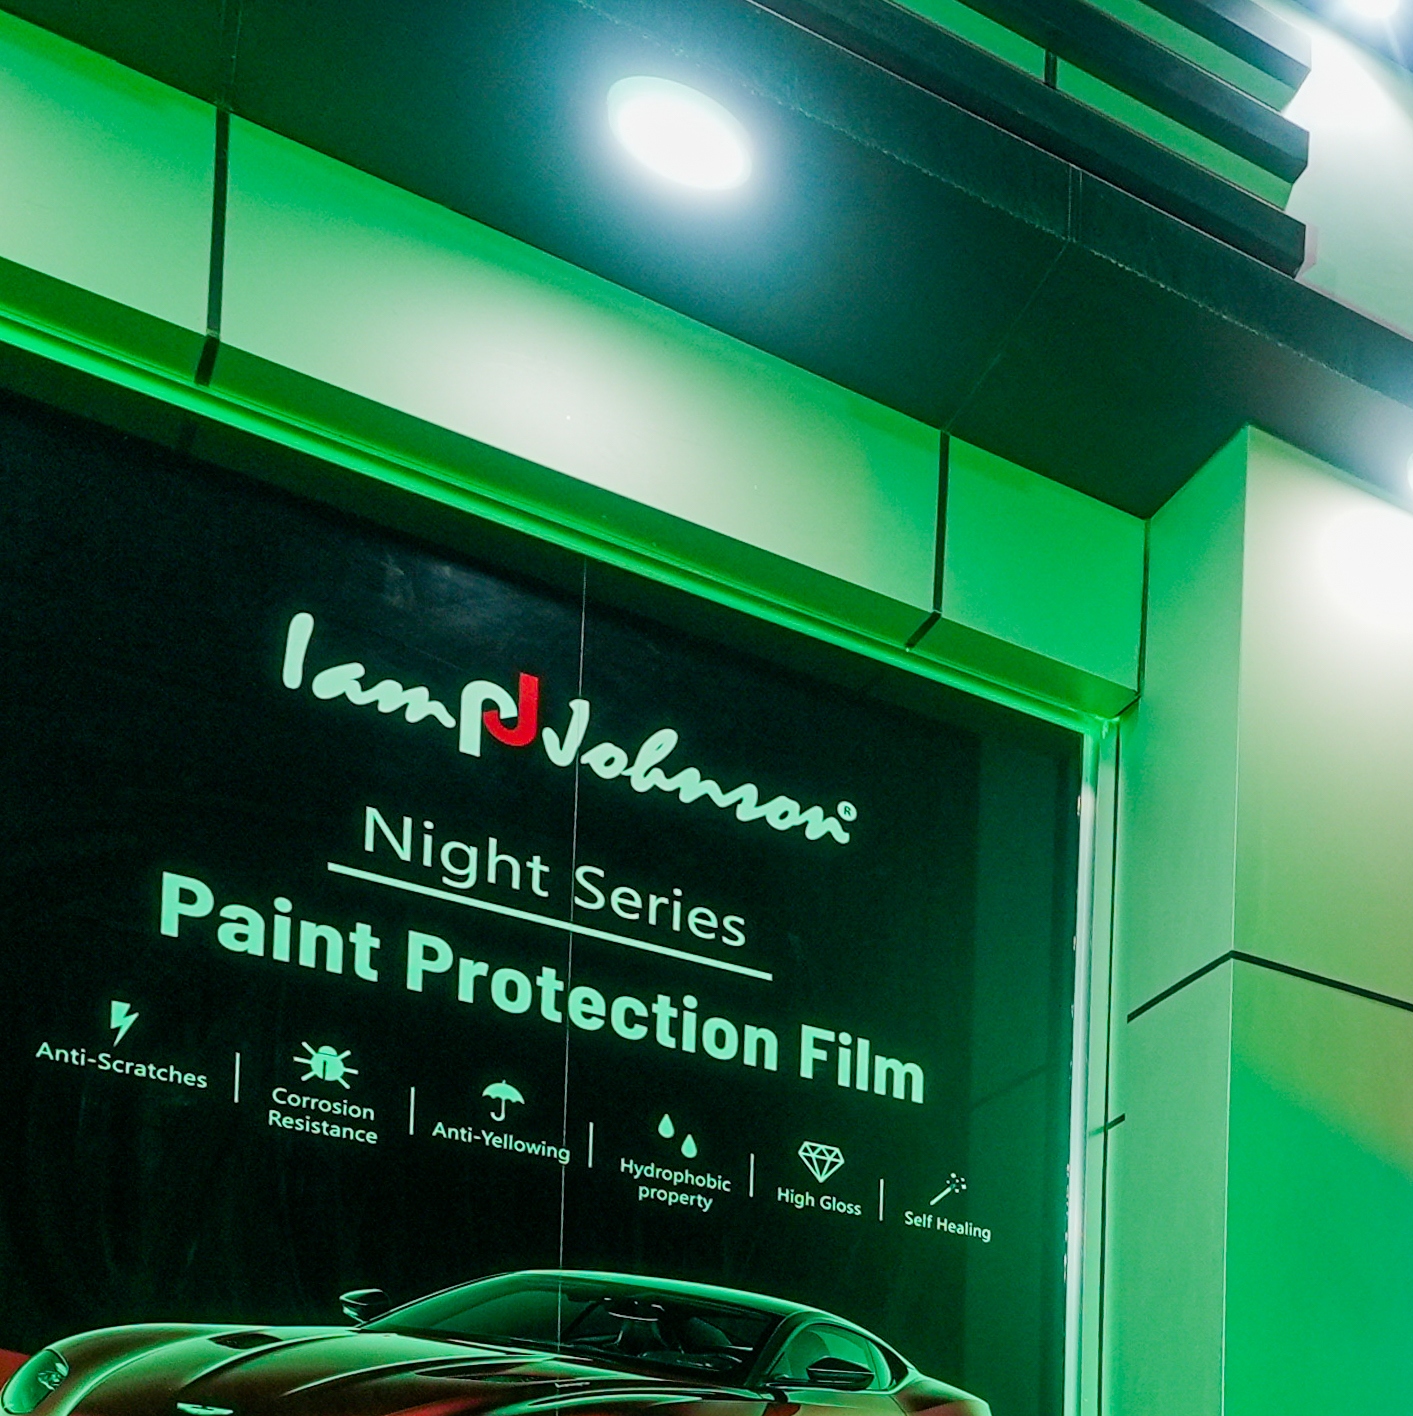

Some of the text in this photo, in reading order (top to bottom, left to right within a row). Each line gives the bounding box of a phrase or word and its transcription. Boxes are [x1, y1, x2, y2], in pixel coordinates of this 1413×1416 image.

[364, 806, 746, 947] Night Series
[160, 871, 924, 1104] Paint Protection Film
[35, 1041, 208, 1089] Anti-Scratches
[272, 1087, 375, 1121] Corrosion
[268, 1110, 378, 1144] Resistance
[431, 1121, 570, 1165] Anti-Yellowing
[620, 1157, 731, 1192] Hydrophobic
[639, 1185, 713, 1212] property
[777, 1187, 862, 1216] High Gloss
[904, 1211, 992, 1243] Self Healing
